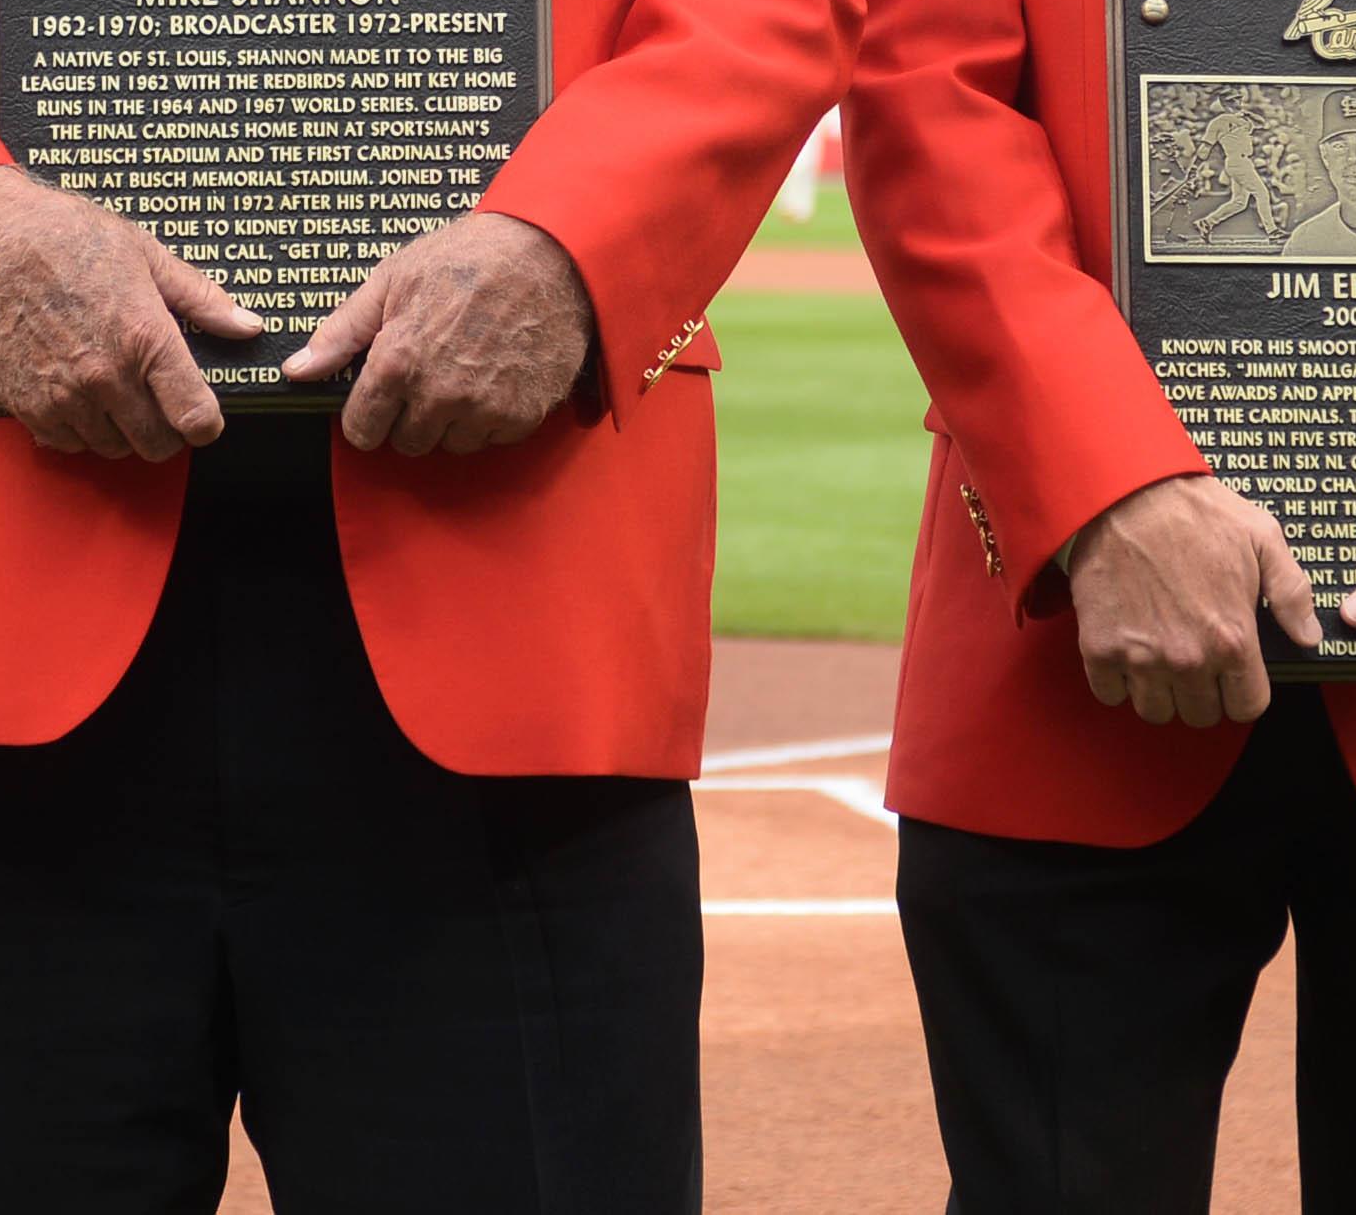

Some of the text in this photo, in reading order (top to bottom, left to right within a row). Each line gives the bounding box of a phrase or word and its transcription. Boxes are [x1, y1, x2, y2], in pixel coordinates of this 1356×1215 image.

[32, 11, 507, 37] 1962-1970; BROADCASTER 1972-PRESENT
[33, 46, 503, 67] A NATIVE OF ST. LOUIS, SHANNON MADE IT TO THE BIG
[21, 70, 516, 92] LEAGUES IN 1962 WITH THE REDBIRDS AND HIT KEY HOME
[36, 94, 502, 116] RUNS IN THE 1964 AND 1967 WORLD SERIES. CLUBBED
[1266, 271, 1320, 298] JIM
[1161, 338, 1226, 354] KNOWN
[1230, 338, 1263, 354] FOR
[1267, 339, 1294, 355] HIS
[1154, 360, 1231, 378] CATCHES,
[1236, 361, 1297, 377] "JIMMY
